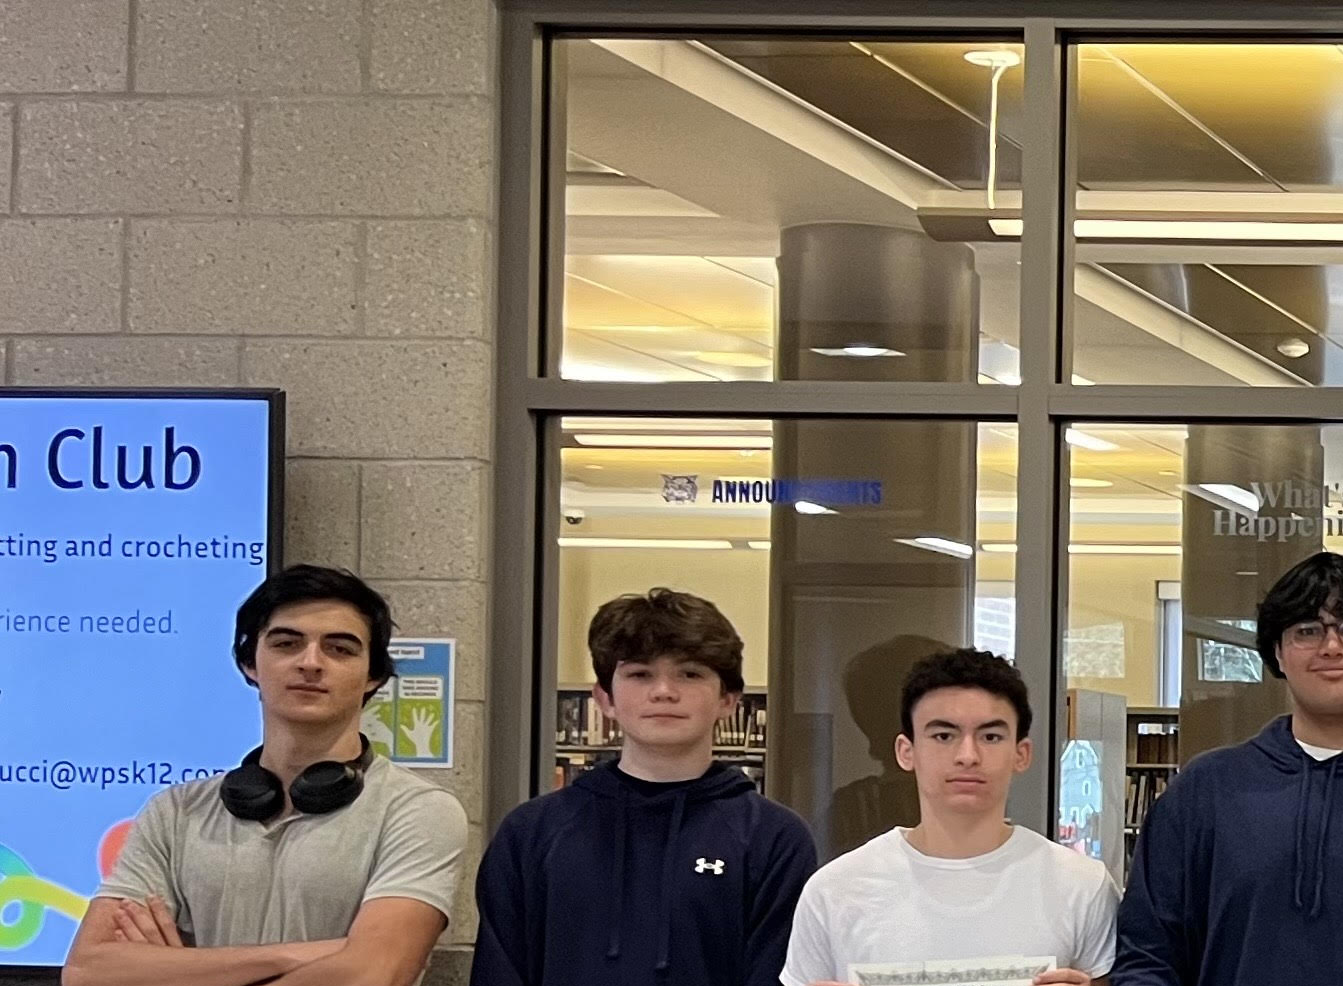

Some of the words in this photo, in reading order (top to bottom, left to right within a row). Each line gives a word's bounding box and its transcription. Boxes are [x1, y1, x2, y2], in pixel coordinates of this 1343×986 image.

[48, 426, 201, 490] Club
[66, 533, 112, 557] and
[121, 534, 264, 565] crocheting
[80, 609, 178, 634] needed.
